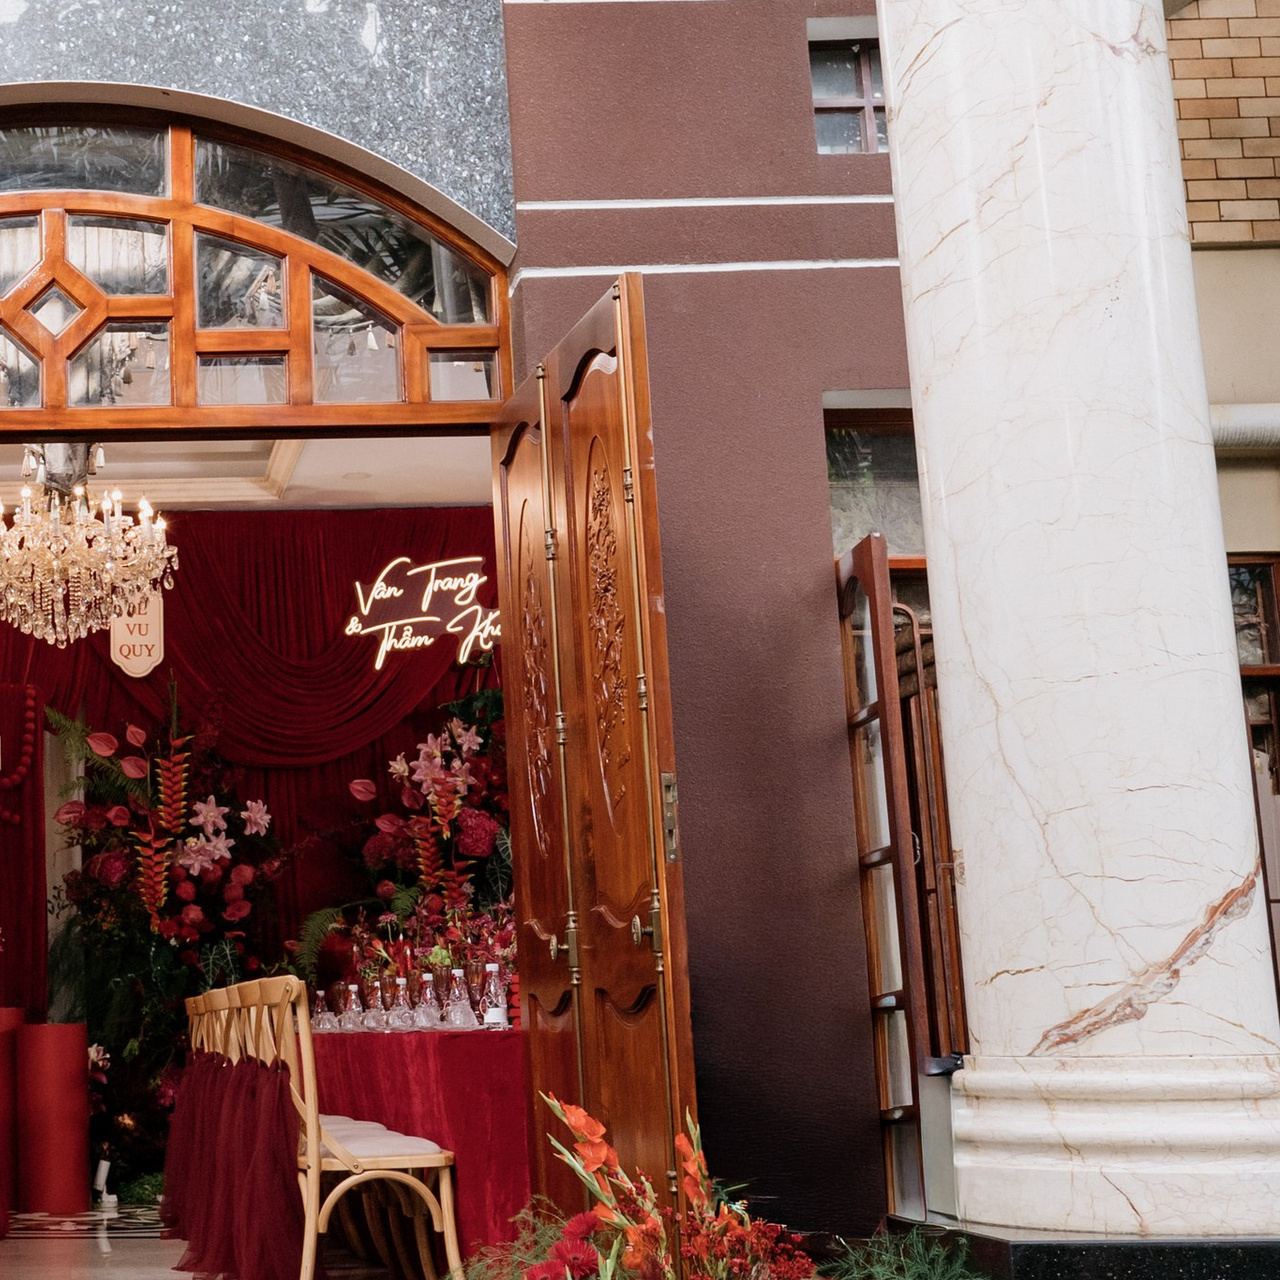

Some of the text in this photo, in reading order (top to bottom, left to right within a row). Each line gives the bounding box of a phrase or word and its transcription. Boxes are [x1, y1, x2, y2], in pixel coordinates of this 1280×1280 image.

[355, 556, 488, 616] Vân Trang
[126, 623, 150, 637] VU
[345, 616, 363, 636] &
[119, 643, 156, 660] QUY
